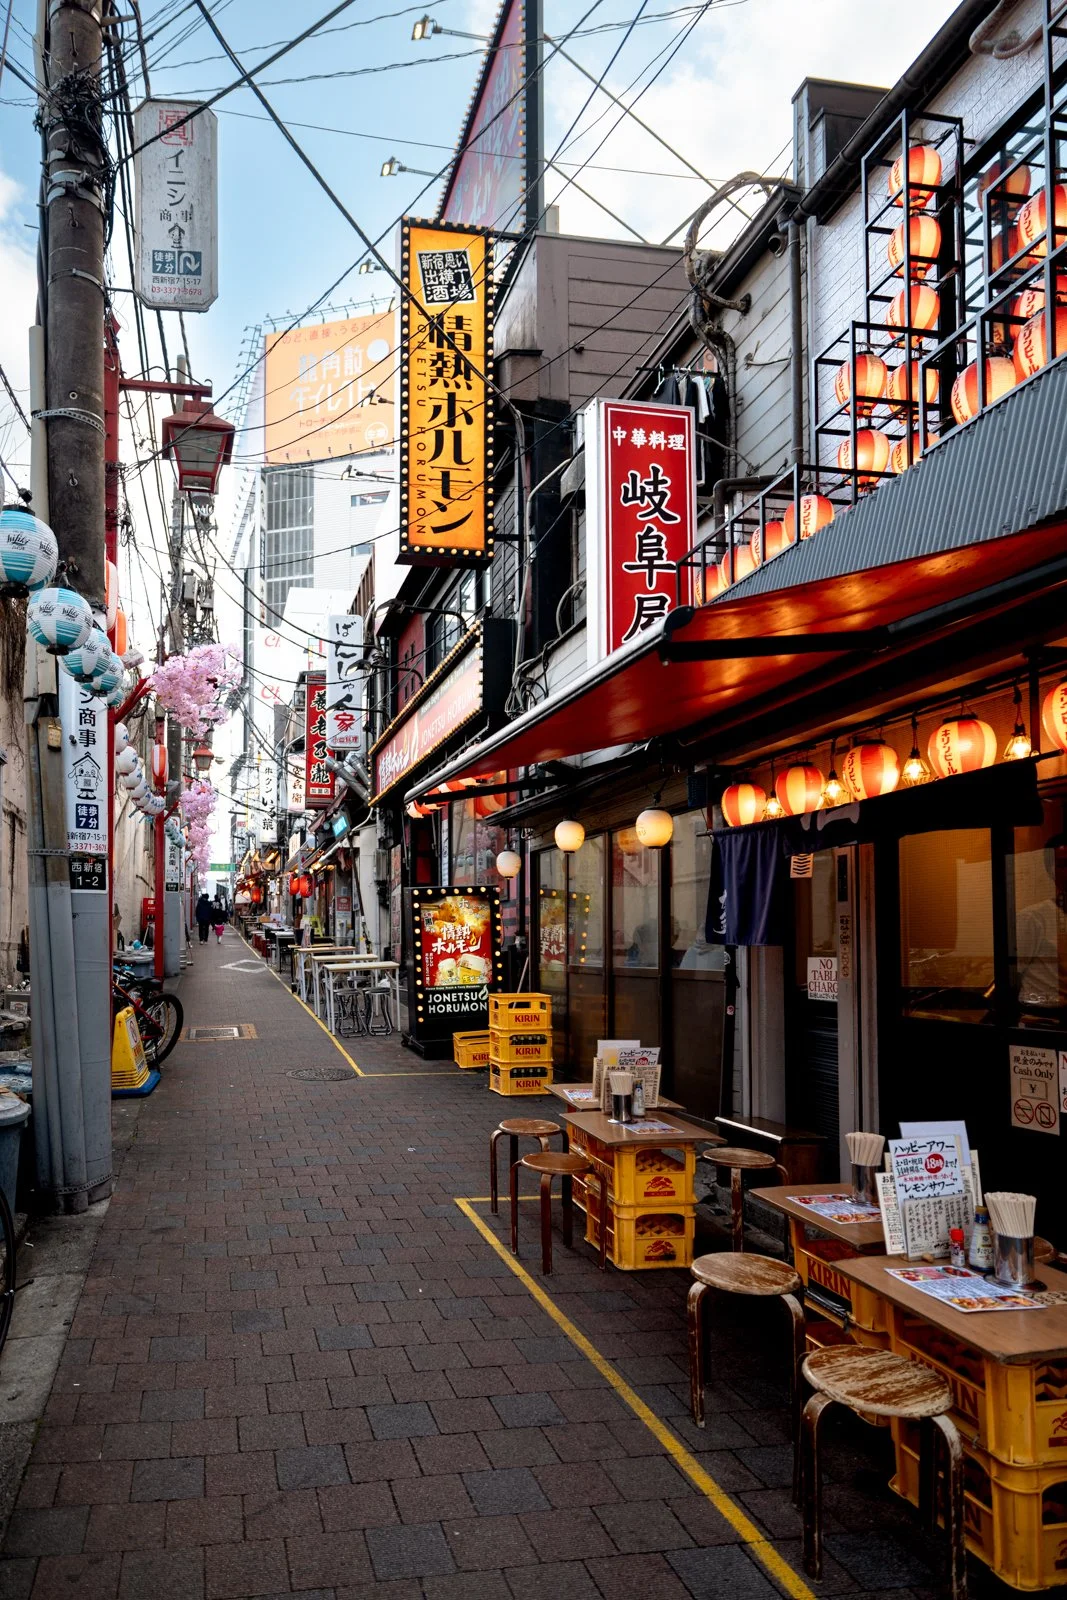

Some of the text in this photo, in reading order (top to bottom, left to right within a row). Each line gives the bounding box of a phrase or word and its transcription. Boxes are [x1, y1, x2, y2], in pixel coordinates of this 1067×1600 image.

[153, 251, 174, 262] 徒歩
[421, 253, 467, 269] 新宿思い
[155, 263, 175, 273] 7分
[424, 268, 470, 285] 出横丁
[426, 284, 473, 301] 酒場
[1023, 320, 1041, 376] キリンビール
[427, 313, 475, 535] 情熱ホルモン
[612, 425, 687, 452] 中華料理
[416, 426, 427, 534] HORUMON
[801, 498, 812, 539] キリンビール
[941, 728, 959, 775] キリンビール
[848, 752, 861, 793] キリンビール
[77, 805, 98, 817] 徒歩
[79, 818, 98, 828] 7分
[71, 861, 103, 873] 西新宿
[77, 875, 99, 887] 1-2
[441, 922, 472, 941] 情熱
[431, 937, 482, 955] ホルモン
[819, 958, 833, 970] NO
[427, 991, 479, 1003] JONETSU
[428, 1001, 489, 1014] HORUMON
[514, 1014, 541, 1023] KIRIN
[472, 1052, 490, 1062] KIRI
[515, 1047, 541, 1056] KIRIN
[1013, 1065, 1055, 1081] Cash Only
[515, 1080, 541, 1088] KIRIN
[894, 1140, 956, 1154] ハッピーアワー
[807, 1256, 852, 1301] KIRIN
